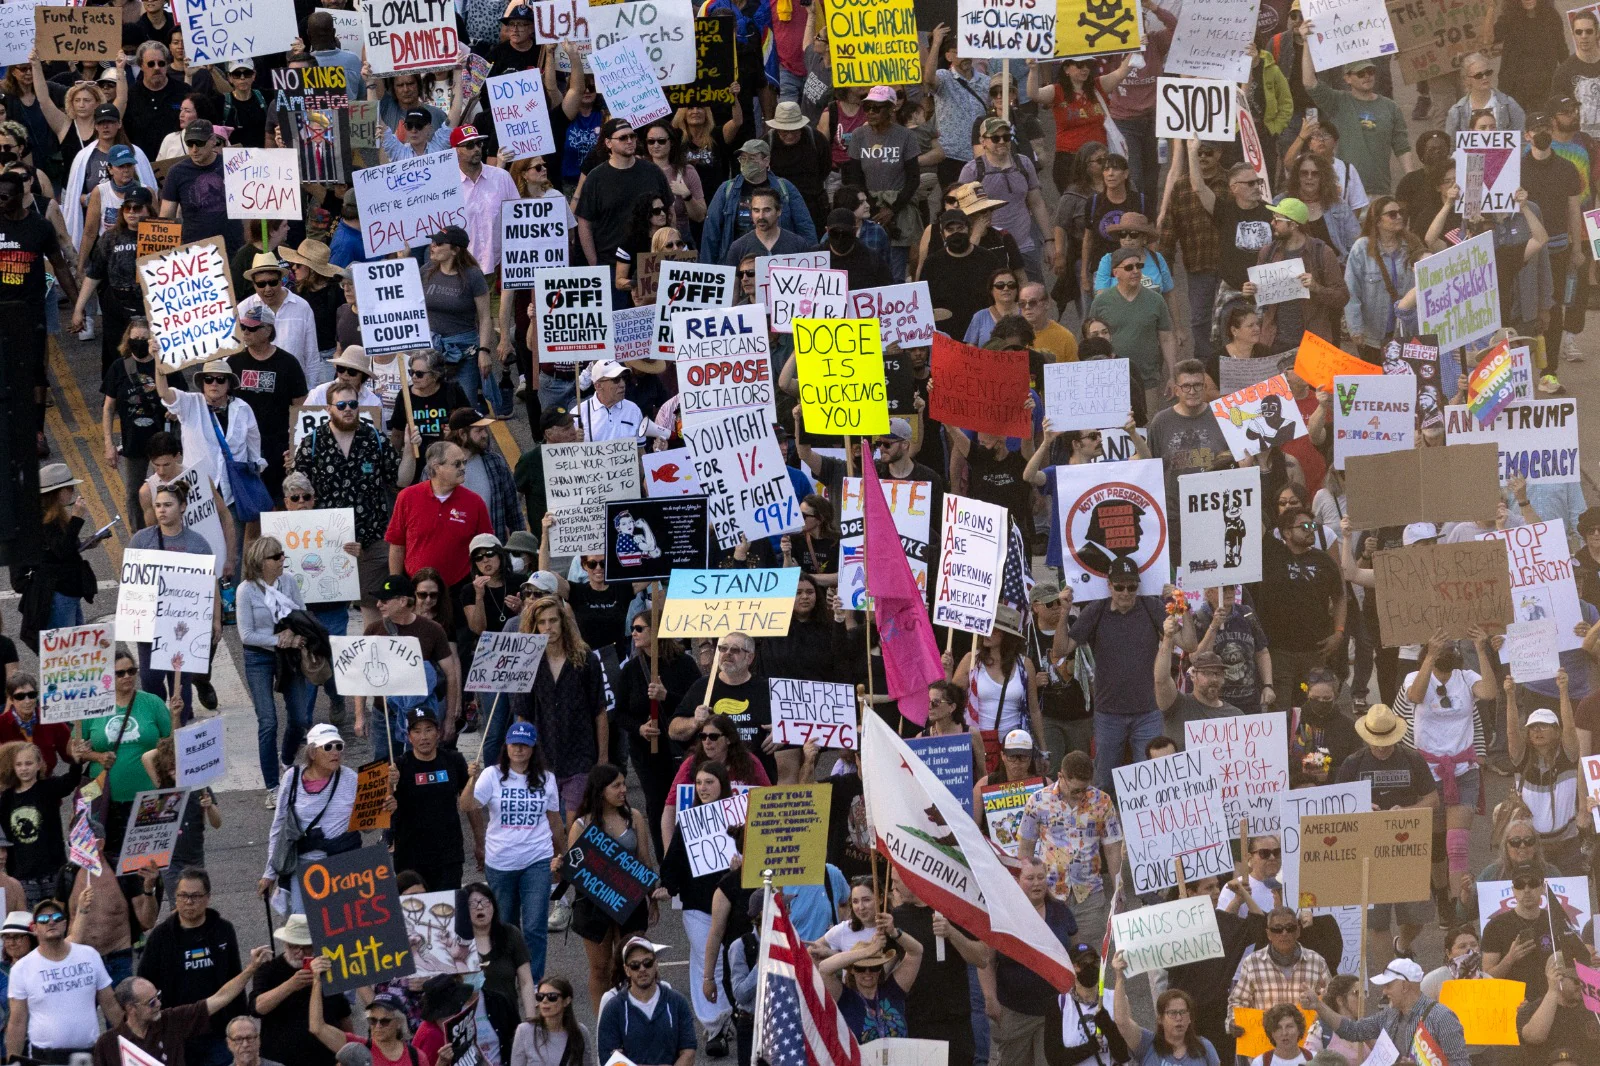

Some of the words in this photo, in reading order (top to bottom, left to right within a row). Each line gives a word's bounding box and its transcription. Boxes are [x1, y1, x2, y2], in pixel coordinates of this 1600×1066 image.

[43, 9, 77, 24] Fund
[82, 10, 115, 26] Facts
[538, 1, 588, 40] Ugh
[616, 3, 657, 28] NO
[831, 9, 916, 39] OLIGARCHY
[961, 11, 984, 26] THE
[984, 9, 1055, 31] OLIGARCHY
[69, 25, 88, 35] not
[1206, 29, 1253, 42] MEASLES
[53, 33, 107, 54] Felons
[369, 31, 390, 47] BE
[390, 26, 458, 64] DAMNED
[837, 45, 855, 55] NO
[858, 42, 917, 56] UNELECTED
[982, 34, 1003, 50] ALL
[1026, 32, 1053, 56] US
[272, 69, 299, 90] NO
[302, 65, 346, 89] KINGS
[838, 59, 919, 85] BILLIONAIRES
[493, 82, 514, 100] DO
[518, 78, 541, 95] YOU
[494, 107, 524, 122] HEAR
[525, 98, 545, 112] THE
[1163, 84, 1230, 135] STOP!
[506, 118, 545, 139] PEOPLE
[513, 136, 544, 156] SING?
[1456, 132, 1517, 150] NEVER
[401, 156, 435, 173] EATING
[440, 151, 454, 164] THE
[861, 147, 900, 161] NOPE
[242, 166, 273, 184] THIS
[278, 167, 293, 182] IS
[386, 168, 433, 188] CHECKS
[242, 180, 298, 211] SCAM
[407, 192, 440, 207] EATING
[442, 187, 457, 200] THE
[513, 202, 555, 219] STOP
[151, 227, 171, 239] The
[505, 222, 566, 239] MUSK'S
[139, 235, 180, 248] FASCIST
[505, 249, 539, 265] WAR
[545, 248, 564, 263] ON
[156, 253, 210, 287] SAVE
[368, 263, 405, 280] STOP
[669, 269, 726, 285] HANDS
[155, 274, 214, 303] VOTING
[375, 284, 405, 301] THE
[544, 277, 602, 291] HANDS
[667, 281, 725, 305] OFF!
[816, 273, 843, 296] ALL
[165, 290, 219, 315] RIGHTS
[546, 288, 603, 314] OFF!
[852, 290, 920, 319] Blood
[163, 301, 227, 332] PROTECT
[362, 308, 427, 326] BILLIONAIRE
[543, 311, 608, 330] SOCIAL
[686, 313, 753, 340] REAL
[897, 315, 918, 327] on
[160, 315, 237, 353] DEMOCRACY
[374, 324, 421, 343] COUP!
[544, 327, 608, 344] SECURITY
[796, 322, 874, 356] DOGE
[676, 335, 768, 360] AMERICANS
[1404, 351, 1437, 361] REICH
[688, 359, 770, 385] OPPOSE
[823, 358, 855, 378] IS
[684, 384, 771, 410] DICTATORS
[801, 382, 885, 405] CUCKING
[1337, 383, 1411, 417] VETERANS
[820, 406, 861, 429] YOU
[1368, 415, 1381, 430] 4
[684, 421, 727, 457] YOU
[724, 408, 771, 445] FIGHT
[1338, 428, 1406, 442] DEMOCRACY
[546, 446, 580, 458] DUMP
[581, 443, 606, 456] YOUR
[605, 441, 636, 455] STOCK
[555, 458, 581, 471] SELL
[583, 456, 606, 469] YOUR
[607, 454, 636, 467] TESLA
[696, 463, 723, 482] FOR
[737, 446, 764, 483] 1%
[606, 467, 635, 480] DOGE
[551, 487, 571, 498] HOW
[586, 483, 614, 496] FEELS
[621, 479, 635, 490] TO
[710, 496, 738, 518] WE
[741, 475, 786, 510] FIGHT
[1106, 488, 1150, 509] PRESIDENT
[580, 496, 607, 506] LOSE
[753, 496, 800, 533] 99%
[946, 496, 994, 533] MORONS
[285, 531, 325, 550] Off
[944, 525, 967, 554] ARE
[943, 550, 993, 585] GOVERNING
[158, 575, 200, 605] Democracy
[691, 570, 780, 595] STAND
[939, 576, 988, 607] AMERICA!
[704, 601, 763, 611] WITH
[665, 611, 787, 632] UKRAINE
[492, 636, 534, 655] HANDS
[334, 638, 367, 676] TARIFF
[389, 639, 422, 667] THIS
[497, 654, 521, 669] OFF
[44, 667, 105, 687] DIVERSITY
[469, 668, 487, 682] OUR
[491, 669, 536, 683] DEMOCRACY
[778, 700, 846, 724] SINCE
[195, 732, 208, 740] WE
[777, 720, 854, 749] 1776
[1187, 717, 1238, 745] Would
[1242, 721, 1273, 745] you
[186, 738, 217, 754] REJECT
[185, 758, 220, 776] FASCISM
[364, 771, 381, 781] The
[1118, 750, 1202, 793] WOMEN
[357, 776, 388, 792] FASCIST
[1119, 794, 1150, 813] have
[1154, 785, 1181, 808] gone
[1183, 773, 1218, 801] through
[501, 801, 546, 812] RESIST
[359, 817, 377, 828] GO!
[500, 813, 543, 826] RESIST
[678, 800, 728, 842] HUMAN
[1136, 796, 1212, 840] ENOUGH
[1304, 820, 1359, 834] AMERICANS
[1384, 819, 1420, 830] TRUMP
[584, 824, 616, 859] RAGE
[613, 850, 661, 889] AGAINST
[690, 835, 732, 876] FOR
[764, 856, 784, 865] OFF
[766, 845, 800, 855] HANDS
[1304, 848, 1322, 861] OUR
[1323, 847, 1357, 861] ALLIES
[1373, 846, 1391, 859] OUR
[1391, 843, 1428, 858] ENEMIES
[885, 831, 969, 894] CALIFORNIA
[1134, 859, 1177, 891] GOING
[1179, 841, 1234, 881] BACK!
[303, 863, 391, 901] Orange
[574, 867, 628, 913] MACHINE
[321, 894, 392, 938] LIES
[1115, 911, 1173, 943] HANDS
[1178, 902, 1206, 926] OFF
[322, 935, 409, 983] Matter
[1123, 931, 1222, 974] IMMIGRANTS
[40, 968, 61, 982] THE
[61, 961, 94, 979] COURTS
